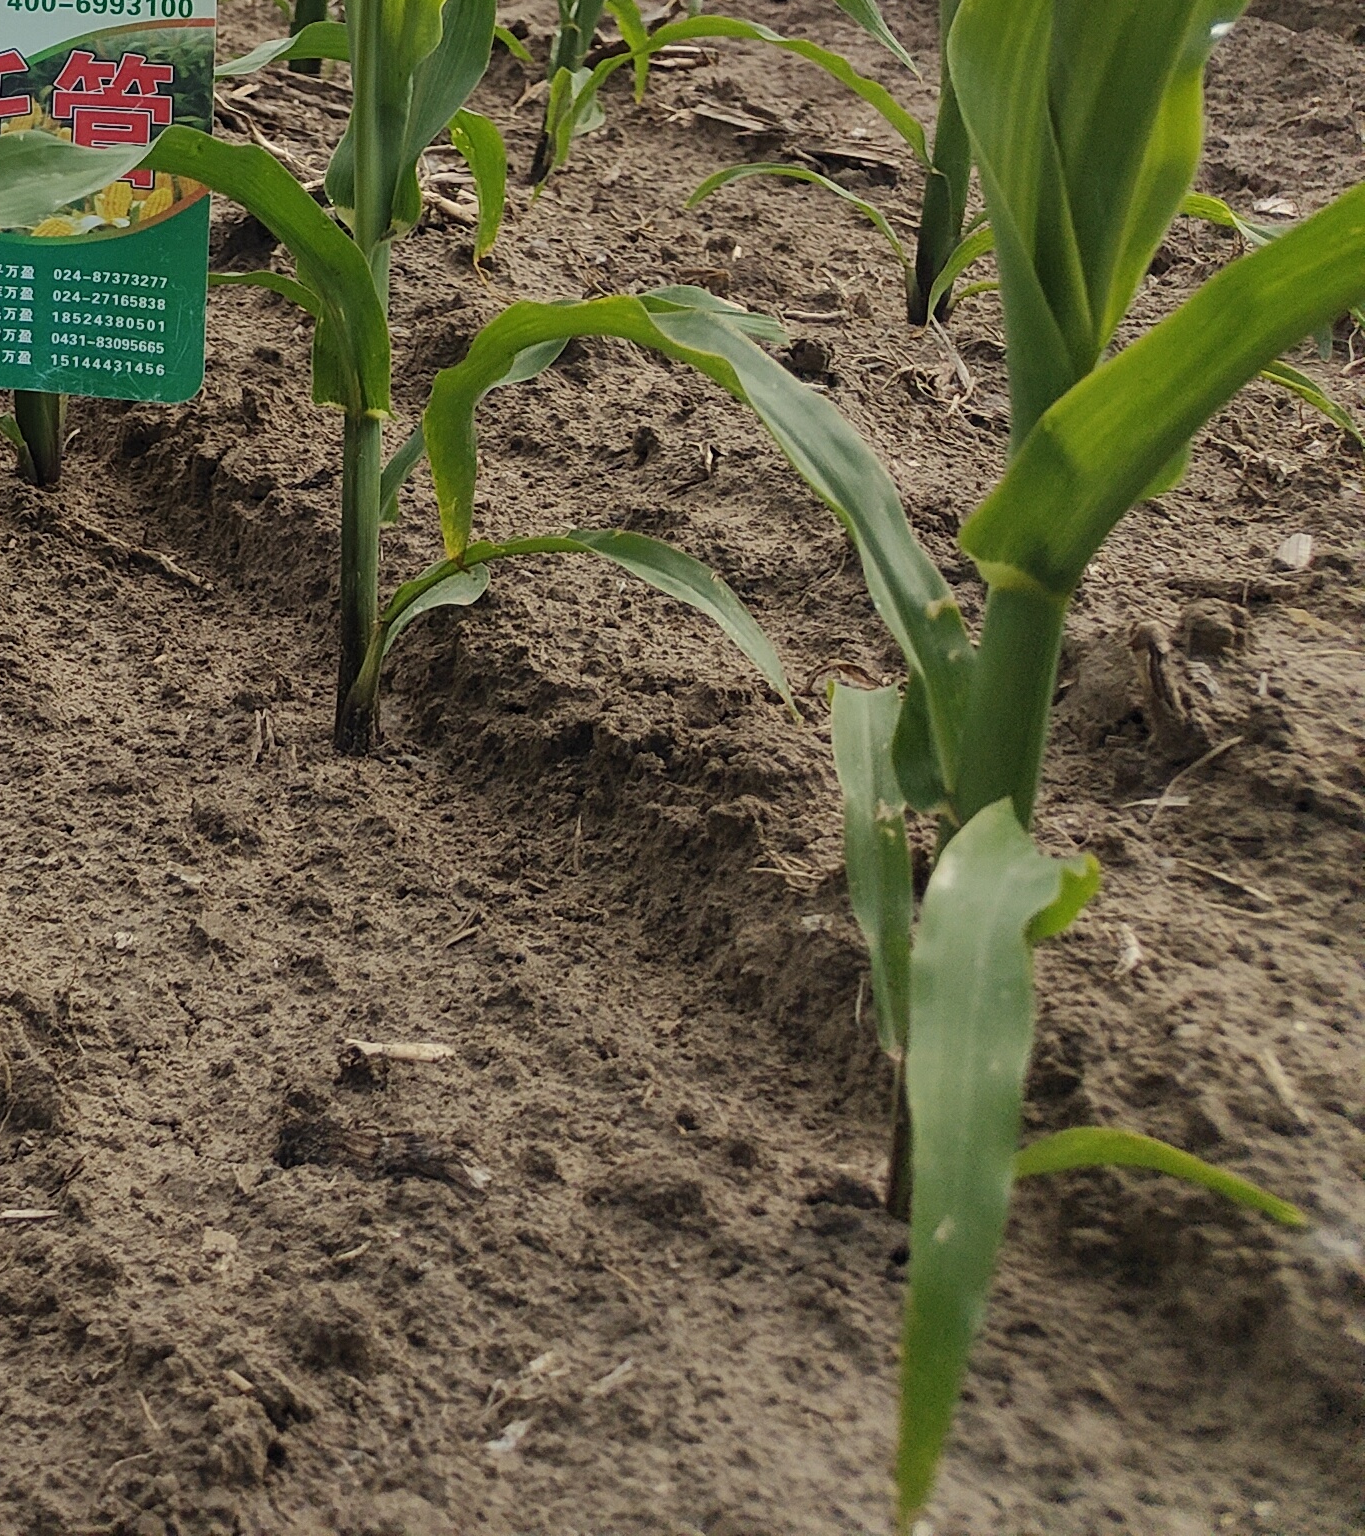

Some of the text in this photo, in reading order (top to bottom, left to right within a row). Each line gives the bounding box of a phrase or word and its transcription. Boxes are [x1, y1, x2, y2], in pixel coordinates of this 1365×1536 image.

[53, 268, 168, 289] 024-87373277
[52, 290, 166, 311] 024-27165838
[52, 311, 165, 333] 18524380501
[51, 332, 165, 355] 0431-83095665
[50, 354, 166, 376] 15144431456
